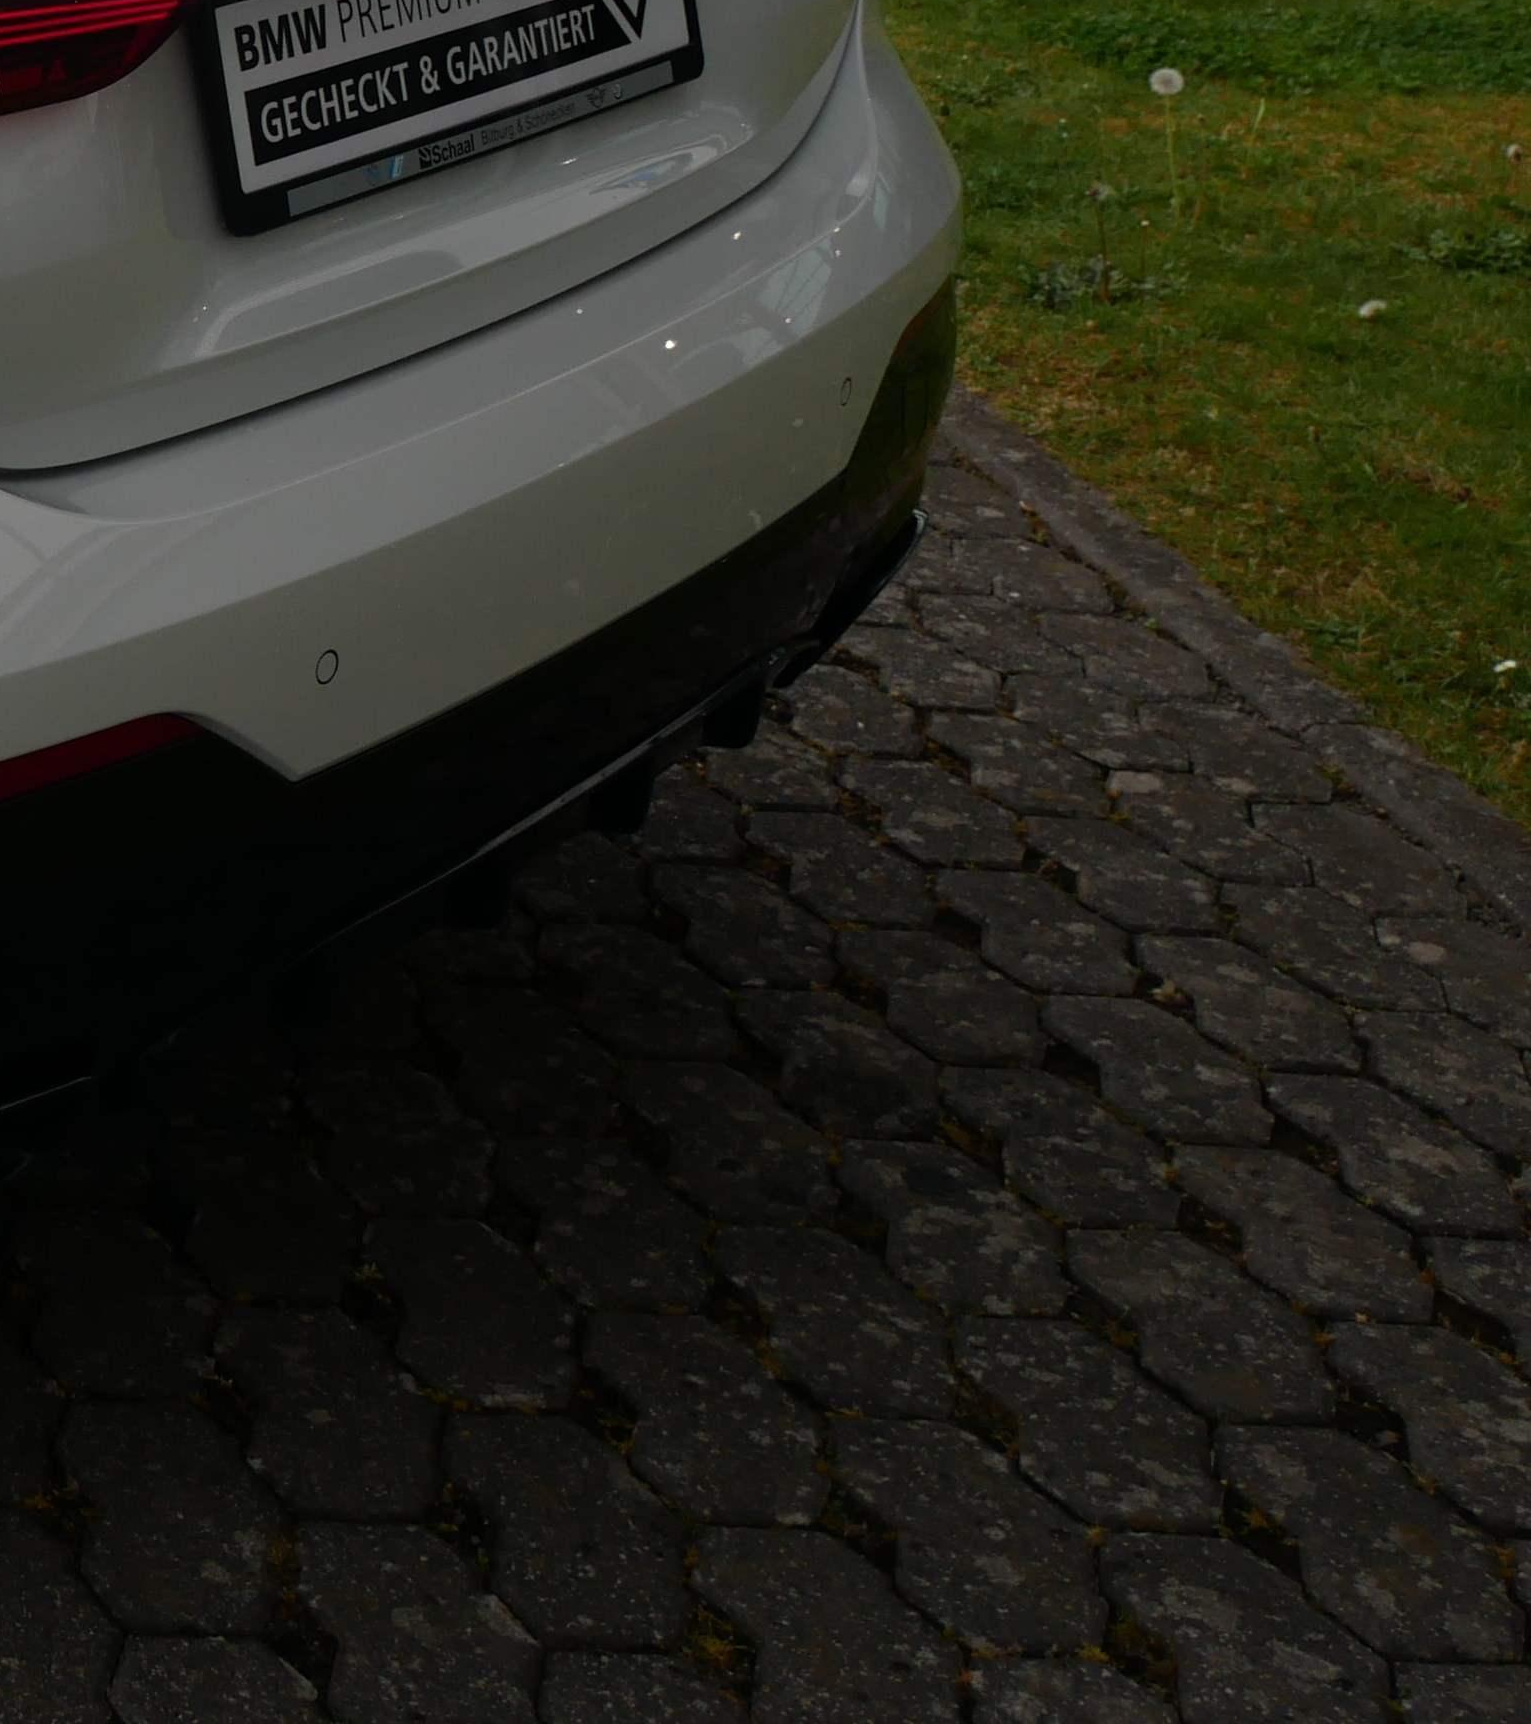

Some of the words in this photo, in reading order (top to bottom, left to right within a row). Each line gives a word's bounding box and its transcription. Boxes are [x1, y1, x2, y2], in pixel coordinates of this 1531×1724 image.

[235, 4, 327, 71] BMW
[261, 62, 408, 144] GECHECKT
[420, 55, 440, 95] &
[446, 4, 596, 85] GARANTIERT
[433, 135, 476, 164] Schaal
